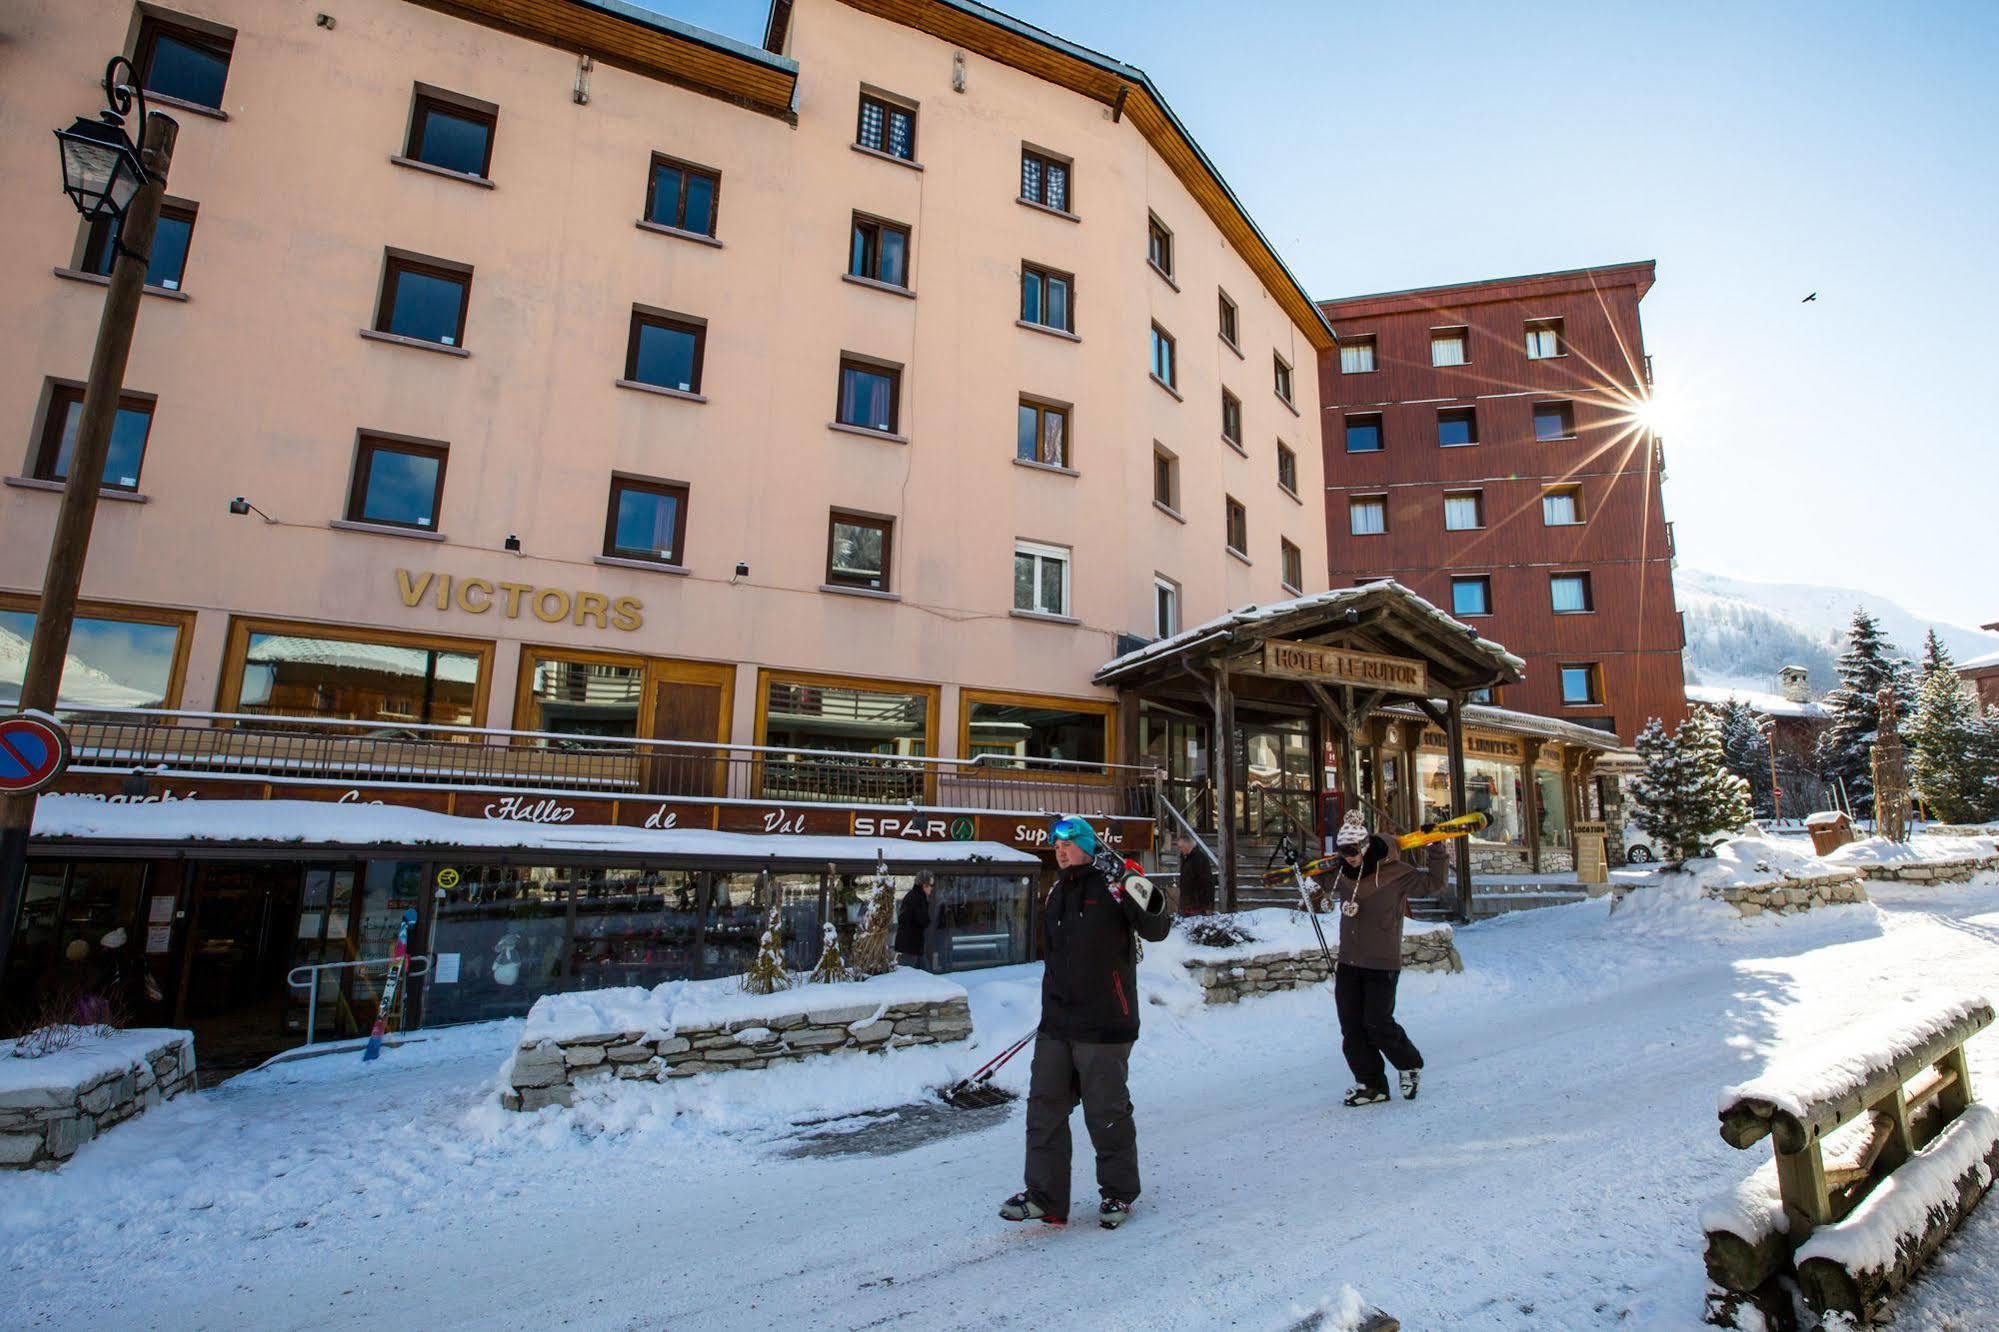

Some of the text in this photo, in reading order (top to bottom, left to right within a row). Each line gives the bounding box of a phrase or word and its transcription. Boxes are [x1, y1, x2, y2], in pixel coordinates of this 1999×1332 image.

[396, 568, 643, 631] VICTORS
[1275, 648, 1331, 674] HOTEL
[1363, 661, 1416, 684] RUITOR
[1468, 737, 1518, 755] LIMITES
[484, 796, 575, 823] Halles
[644, 803, 677, 829] de
[764, 808, 805, 833] Val
[855, 819, 946, 838] SPAR
